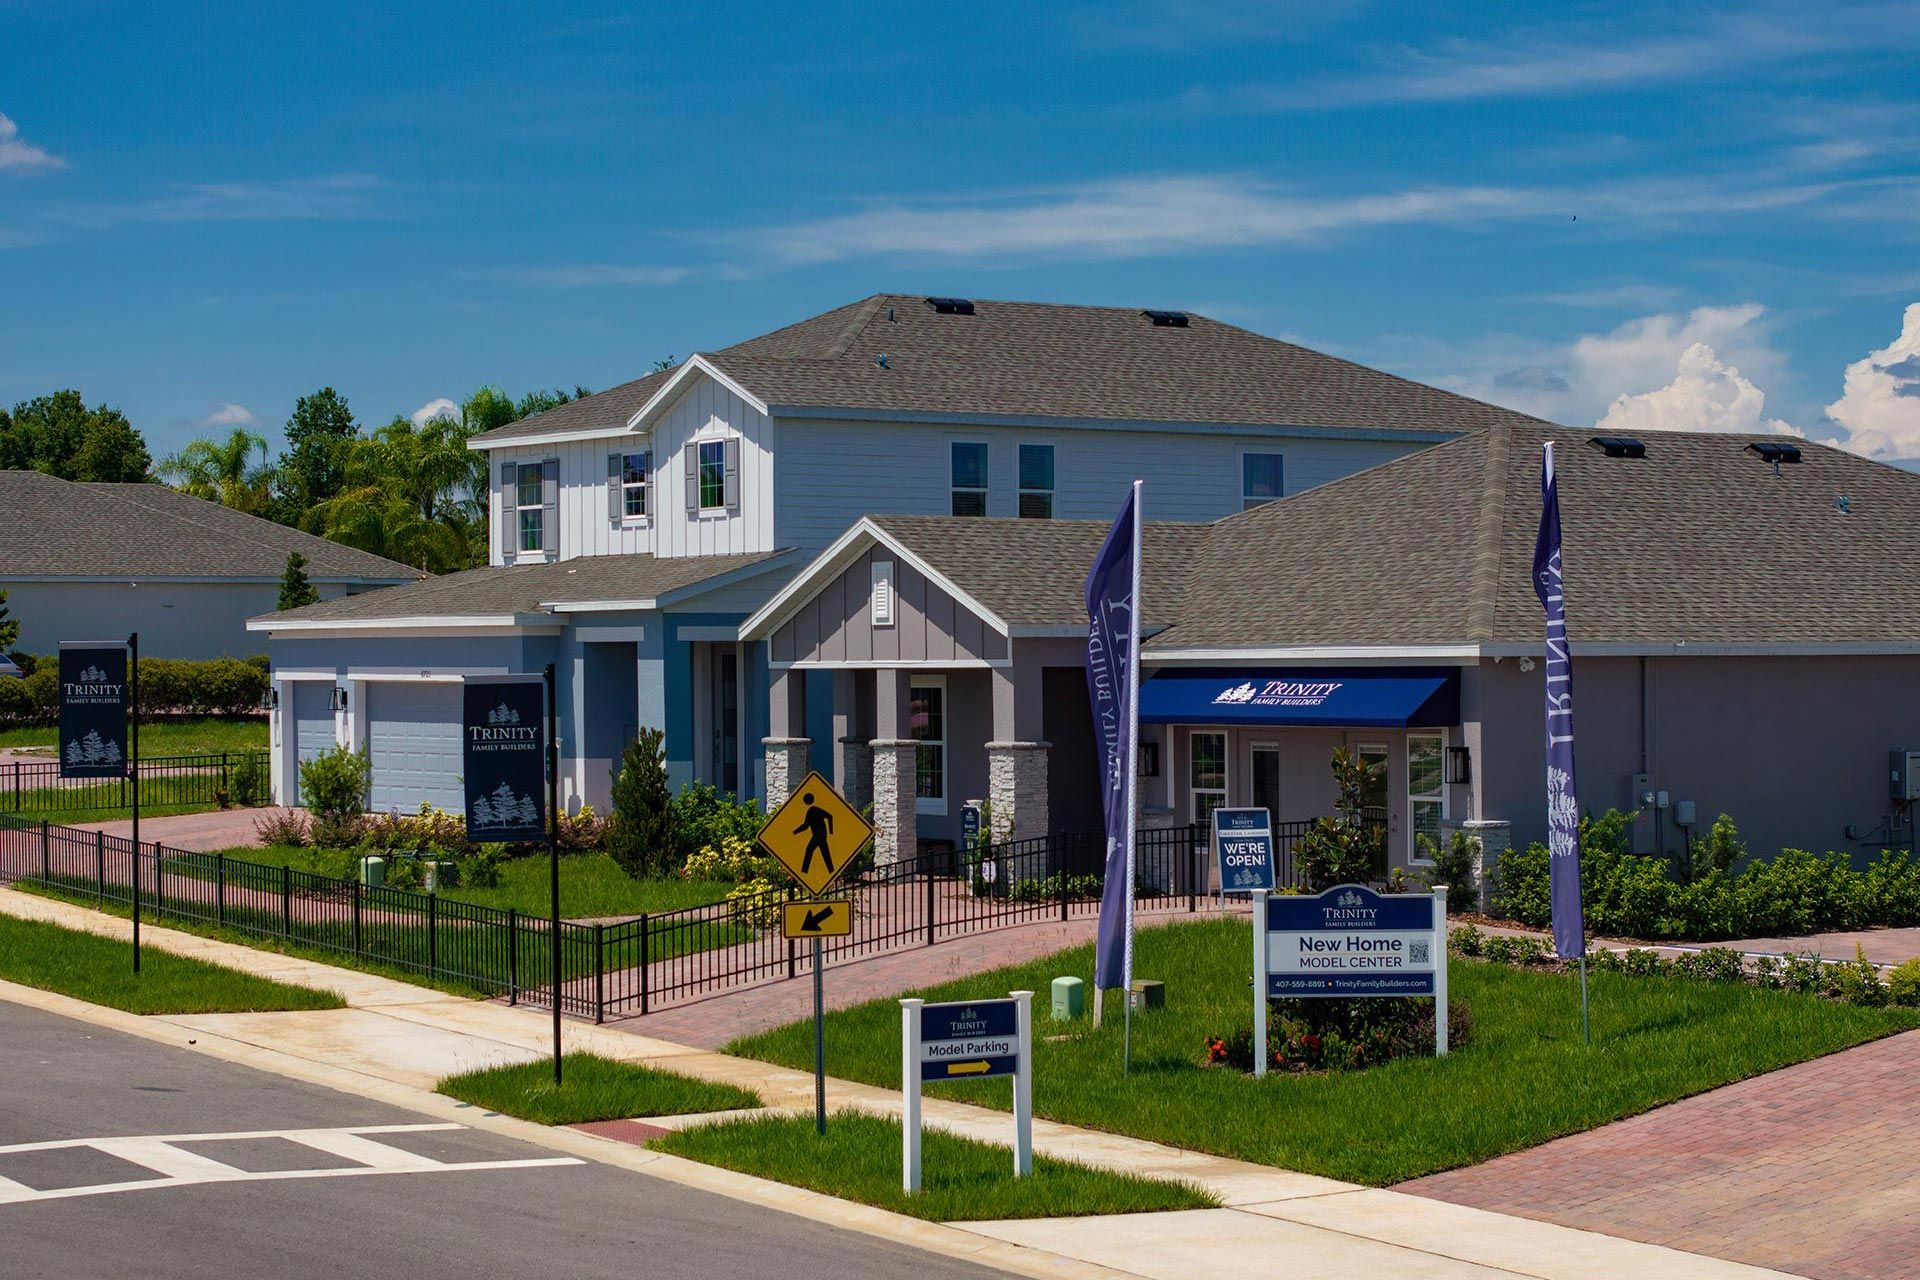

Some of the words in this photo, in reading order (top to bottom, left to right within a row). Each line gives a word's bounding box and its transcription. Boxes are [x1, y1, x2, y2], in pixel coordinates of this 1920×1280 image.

[64, 683, 122, 695] TRINITY
[1260, 681, 1343, 696] TRINITY
[1250, 698, 1282, 706] FAMILY
[1280, 698, 1324, 706] BUILDERS
[469, 726, 538, 740] TRINITY
[472, 744, 499, 752] FAMILY
[500, 743, 536, 751] BUILDERS
[1224, 842, 1266, 854] WE'RE
[1226, 855, 1266, 867] OPEN!
[1322, 907, 1377, 919] TRINITY
[1347, 920, 1376, 928] BUILDERS
[1300, 937, 1341, 952] New
[1346, 936, 1403, 952] Home
[1300, 957, 1346, 968] MODEL
[1349, 957, 1402, 968] CENTER
[1335, 979, 1427, 989] TrinityFamilyBuilders.com
[950, 1020, 988, 1031] TRINITY
[929, 1043, 964, 1056] Model
[967, 1041, 1009, 1054] Parking
